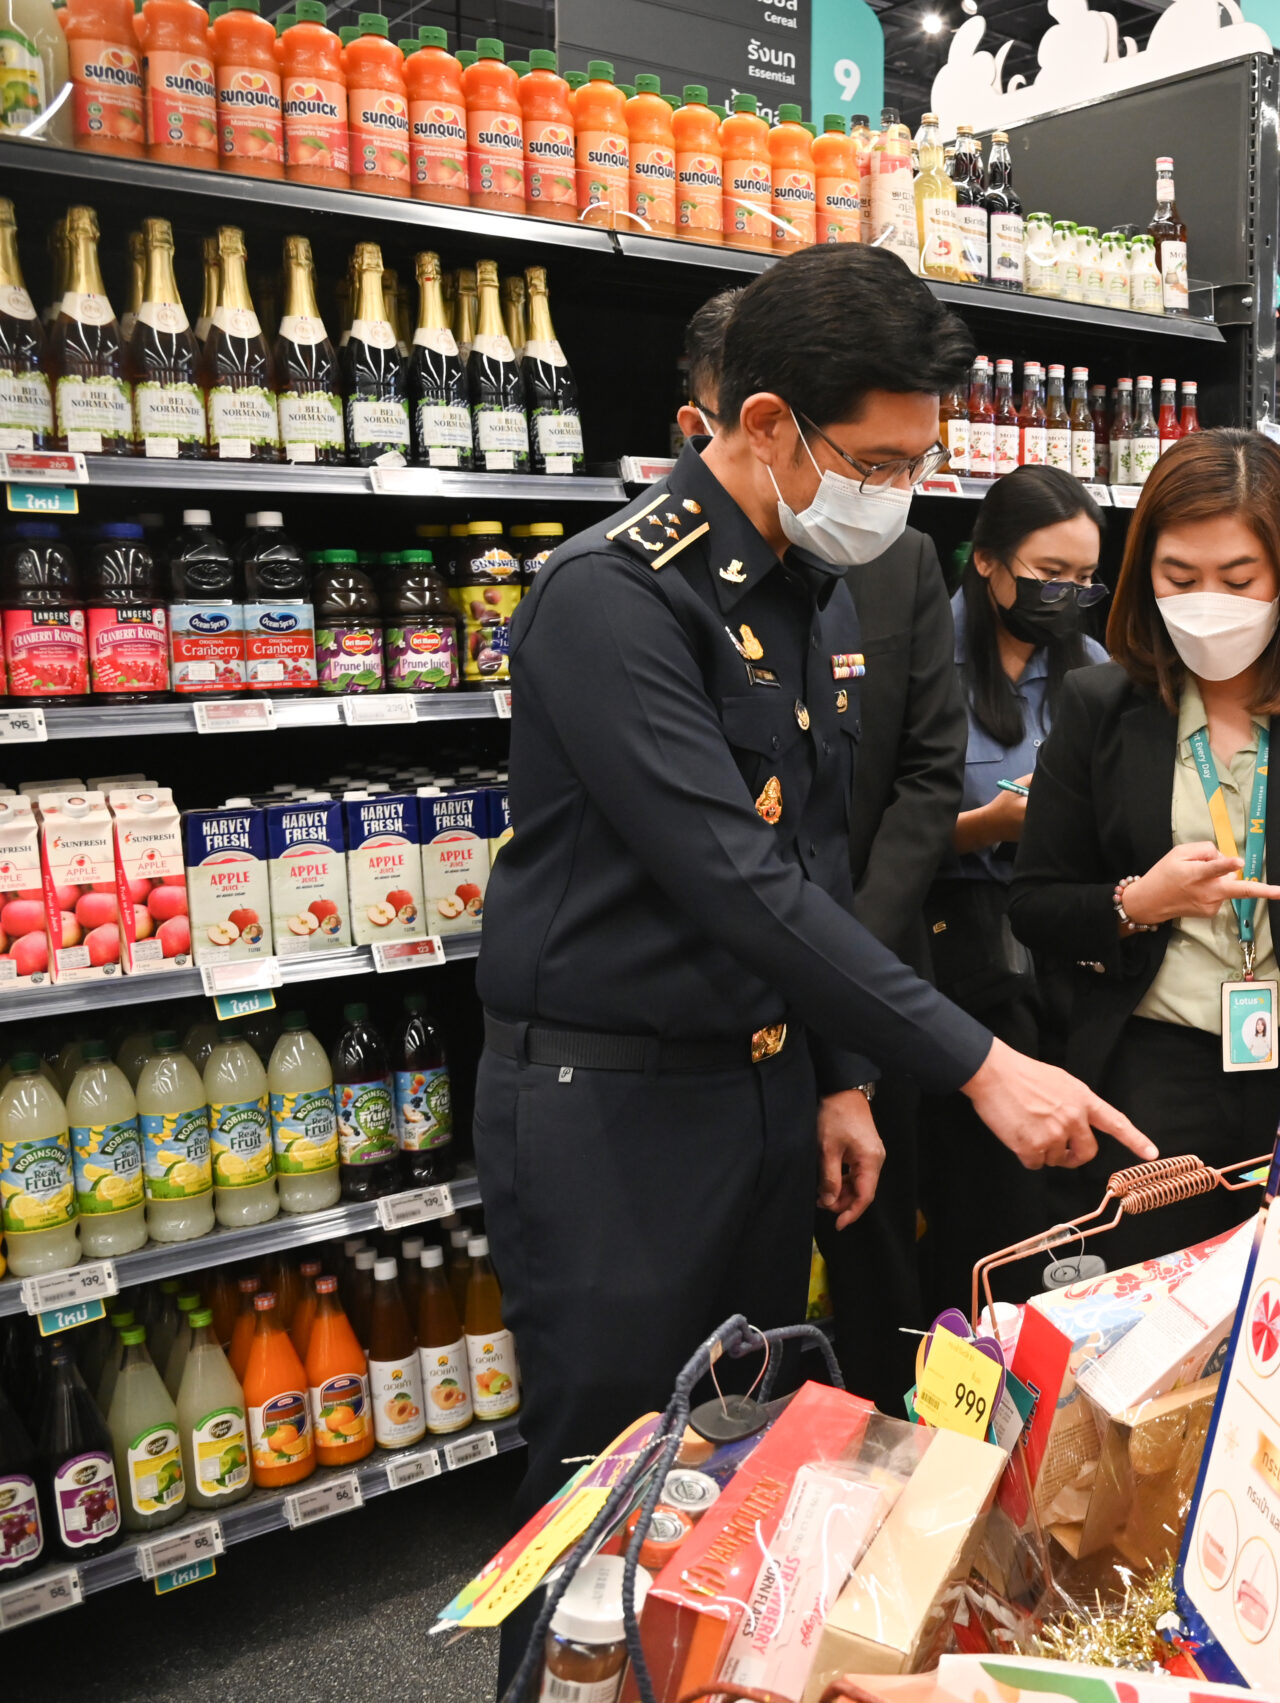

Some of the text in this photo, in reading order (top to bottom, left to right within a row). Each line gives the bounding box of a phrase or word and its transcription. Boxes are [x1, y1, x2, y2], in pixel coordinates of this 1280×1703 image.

[764, 12, 798, 28] Cereal
[748, 39, 796, 69] รังนก
[748, 65, 796, 85] Essential
[833, 59, 861, 102] 9
[71, 399, 125, 412] NORMANDE
[149, 404, 201, 417] NORMANDE
[222, 408, 272, 420] NORMANDE
[288, 412, 337, 424] NORMANDE
[49, 460, 69, 470] 269
[25, 493, 60, 511] ใหม่
[33, 611, 70, 624] LANGERS
[117, 608, 152, 622] LANGERS
[13, 631, 54, 647] CRANBERRY
[99, 630, 136, 646] CRANBERRY
[182, 643, 240, 658] Cranberry
[253, 642, 309, 657] Cranberry
[333, 659, 380, 672] Prune Juice
[402, 657, 450, 670] Prune Juice
[9, 719, 30, 730] 195
[1195, 741, 1211, 779] Every Day
[360, 803, 404, 821] HARVEY
[433, 799, 474, 816] HARVEY
[202, 817, 251, 837] HARVEY
[282, 811, 328, 829] HARVEY
[363, 818, 405, 836] FRESH
[435, 813, 474, 830] FRESH
[1249, 818, 1265, 834] M
[60, 838, 107, 849] SUNFRESH
[131, 833, 176, 844] SUNFRESH
[206, 832, 250, 852] FRESH
[285, 826, 328, 845] FRESH
[368, 854, 405, 869] APPLE
[439, 848, 473, 862] APPLE
[66, 867, 97, 877] APPLE
[138, 860, 167, 870] APPLE
[290, 863, 329, 878] APPLE
[209, 871, 250, 886] APPLE
[220, 884, 239, 892] JUICE
[51, 915, 59, 933] Juice
[124, 908, 132, 926] Juice
[230, 996, 260, 1014] ใหม่
[221, 1110, 265, 1133] ROBINSONS
[311, 1114, 329, 1127] Real
[358, 1108, 392, 1125] Fruit
[238, 1127, 258, 1140] Real
[304, 1119, 333, 1137] Fruit
[230, 1132, 263, 1150] Fruit
[15, 1147, 66, 1172] ROBINSONS
[33, 1167, 57, 1180] Real
[24, 1173, 63, 1191] Fruit
[423, 1197, 439, 1207] 139
[81, 1274, 100, 1287] 139
[55, 1304, 88, 1330] ใหม่
[954, 1382, 987, 1424] 999
[336, 1489, 350, 1501] 56
[704, 1475, 789, 1565] VAN HOUTEN
[194, 1537, 209, 1549] 55
[172, 1564, 200, 1587] ใหม่
[50, 1586, 66, 1599] 55
[751, 1554, 801, 1656] STRAWBERRY
